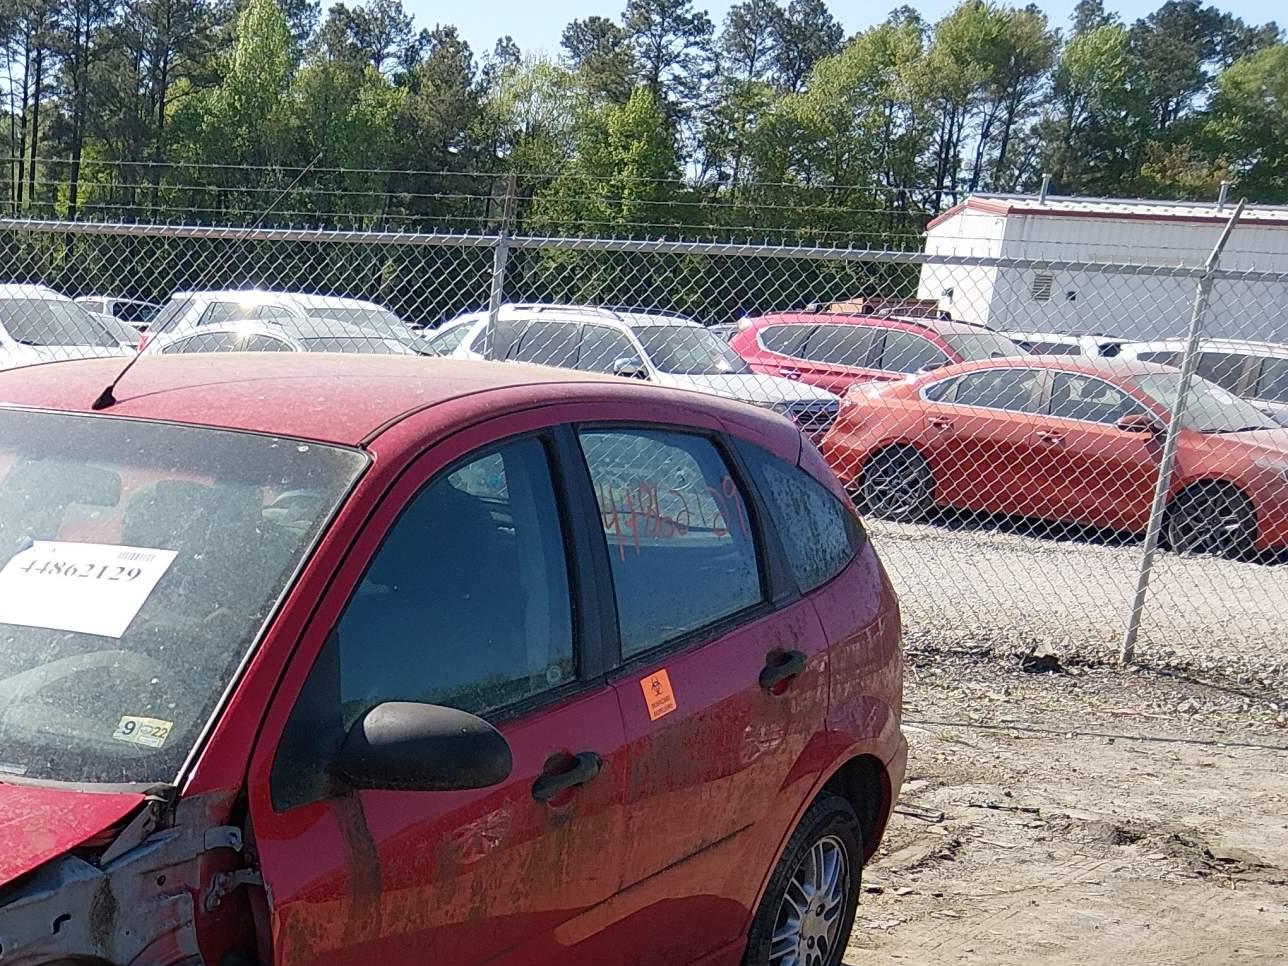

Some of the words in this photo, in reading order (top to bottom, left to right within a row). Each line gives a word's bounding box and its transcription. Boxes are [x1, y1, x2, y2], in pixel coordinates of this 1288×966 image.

[19, 558, 143, 583] 44862129
[122, 720, 137, 735] 9
[150, 726, 168, 739] 22
